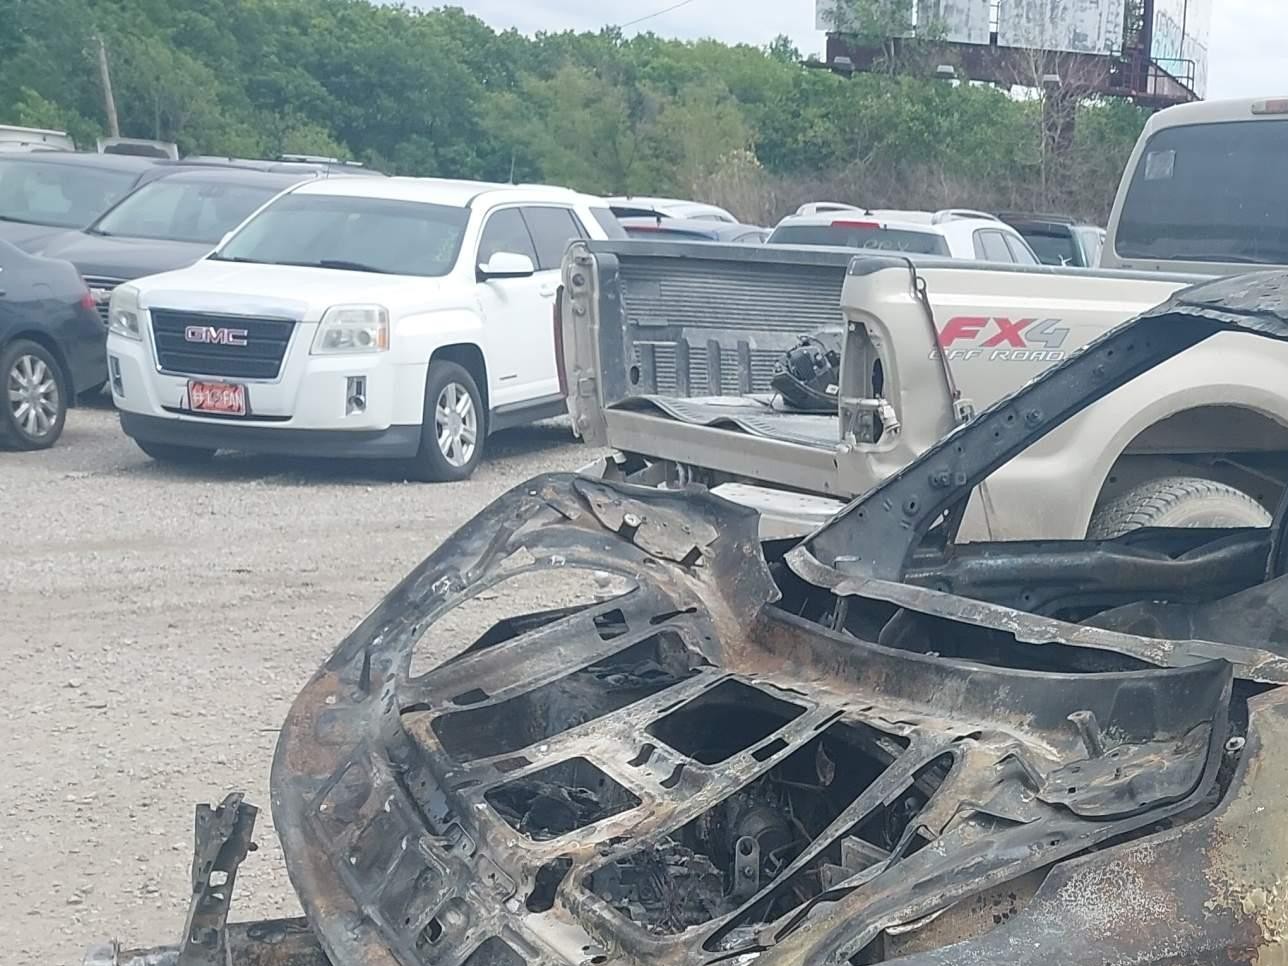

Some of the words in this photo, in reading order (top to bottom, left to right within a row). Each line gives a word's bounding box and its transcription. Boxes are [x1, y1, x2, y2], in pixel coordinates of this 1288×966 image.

[185, 326, 248, 346] GMC
[935, 316, 1070, 348] FX4
[990, 350, 1064, 361] ROAD
